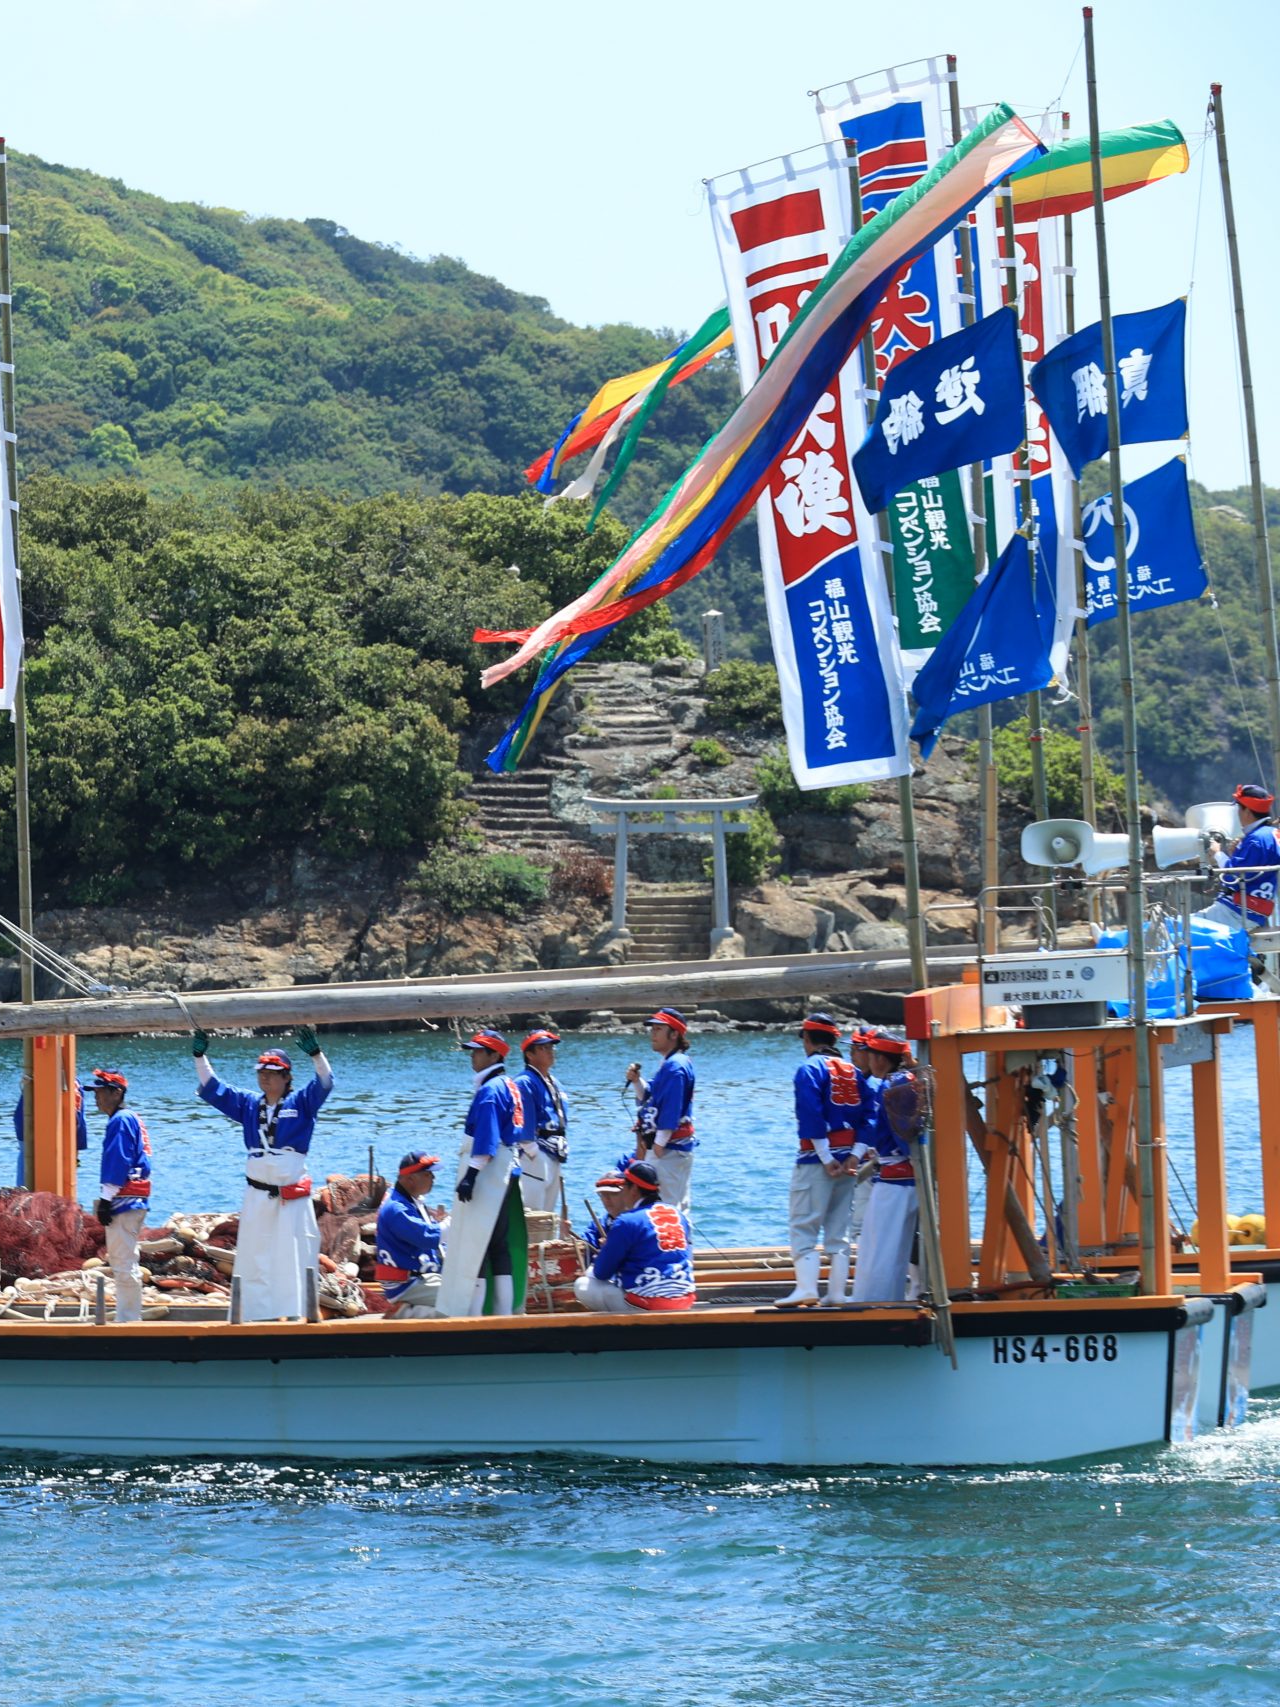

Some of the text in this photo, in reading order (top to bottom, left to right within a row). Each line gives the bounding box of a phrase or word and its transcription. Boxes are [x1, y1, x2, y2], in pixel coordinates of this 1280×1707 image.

[895, 491, 942, 634] コンベンション協会
[808, 599, 847, 750] コンベンション協会
[824, 578, 860, 665] 福山観光
[993, 1334, 1118, 1364] HS4-668
